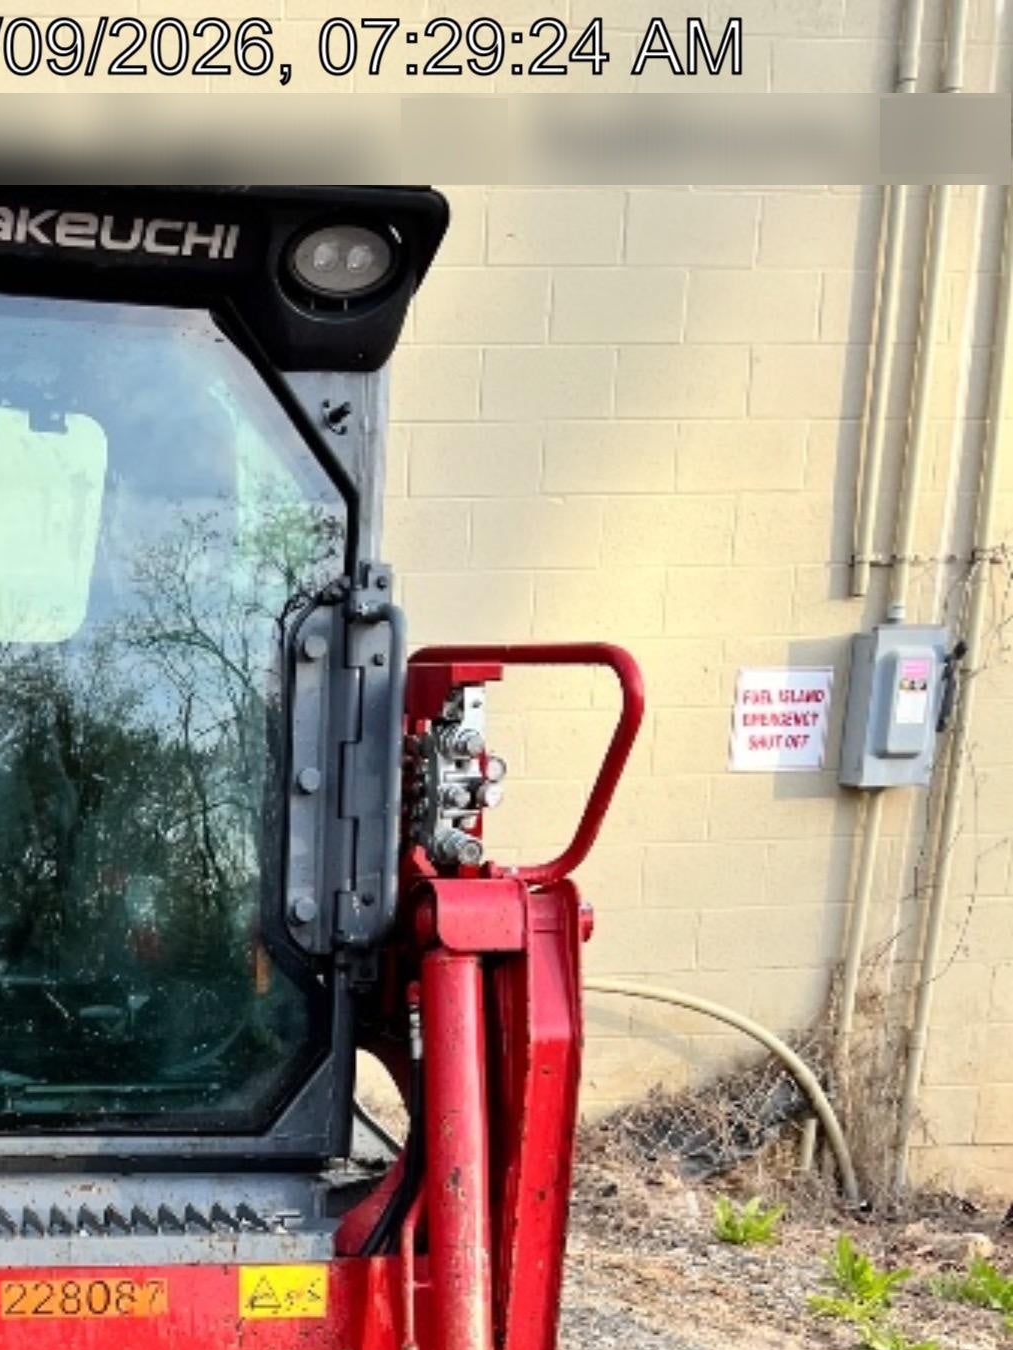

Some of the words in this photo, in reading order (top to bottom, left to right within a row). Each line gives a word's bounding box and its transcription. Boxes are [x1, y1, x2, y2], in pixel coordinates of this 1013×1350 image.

[742, 689, 773, 705] FUEL
[779, 688, 826, 704] ISLAND
[742, 711, 819, 727] EMERGENCY
[4, 1280, 165, 1315] 228087
